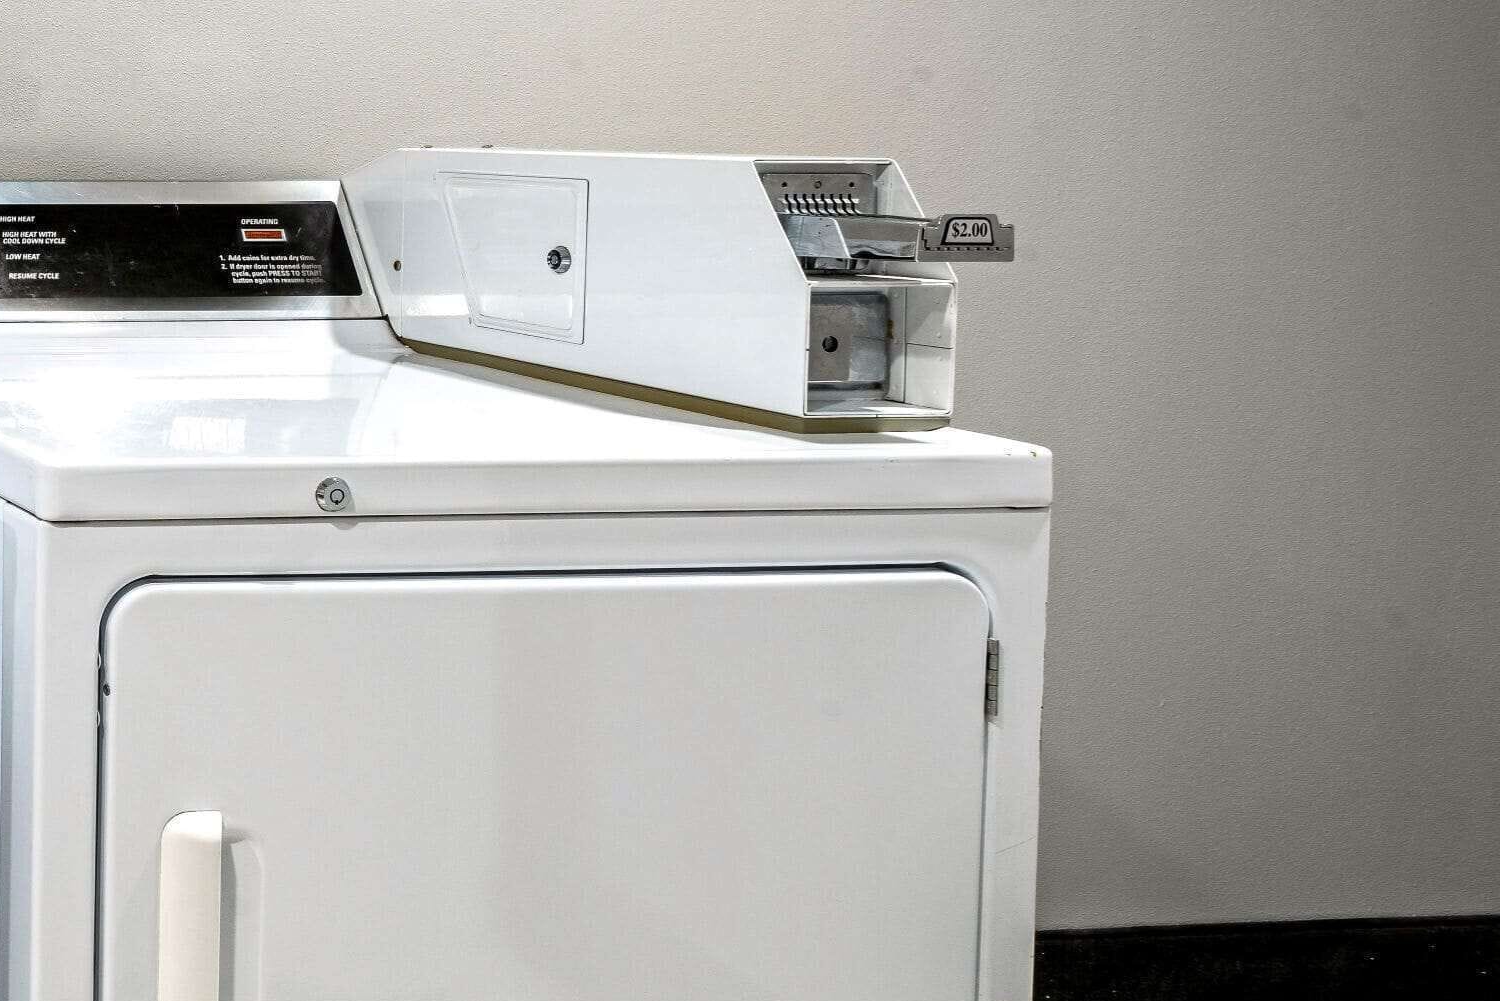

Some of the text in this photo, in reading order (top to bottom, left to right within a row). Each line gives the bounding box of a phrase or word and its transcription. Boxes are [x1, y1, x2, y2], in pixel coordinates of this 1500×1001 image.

[0, 215, 36, 223] HIGH HEAT
[951, 221, 988, 239] $2.00
[3, 237, 67, 245] COOL DOWN CYCLE
[288, 254, 299, 262] dry
[235, 263, 252, 271] dryer
[276, 263, 301, 271] opened
[301, 263, 322, 271] during
[8, 272, 60, 280] RESUME CYCLE
[231, 270, 251, 278] cycle,
[252, 270, 268, 278] push
[254, 277, 273, 285] again
